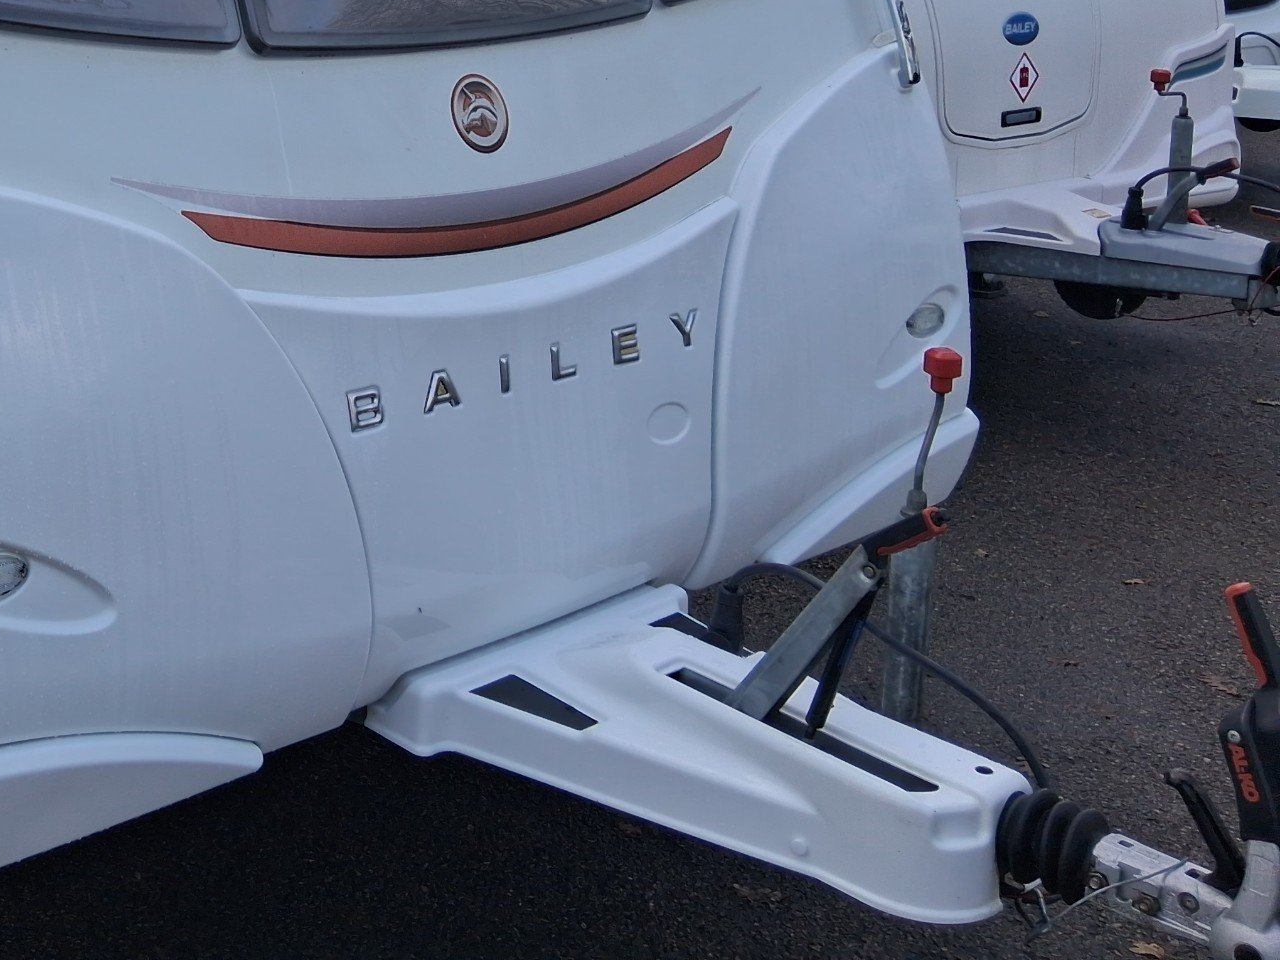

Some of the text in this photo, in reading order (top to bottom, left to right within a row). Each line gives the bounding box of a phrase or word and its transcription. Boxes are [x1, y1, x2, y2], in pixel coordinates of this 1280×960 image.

[1005, 21, 1036, 35] BAILEY
[345, 308, 699, 434] BAILEY
[1228, 742, 1260, 803] AL-KO
